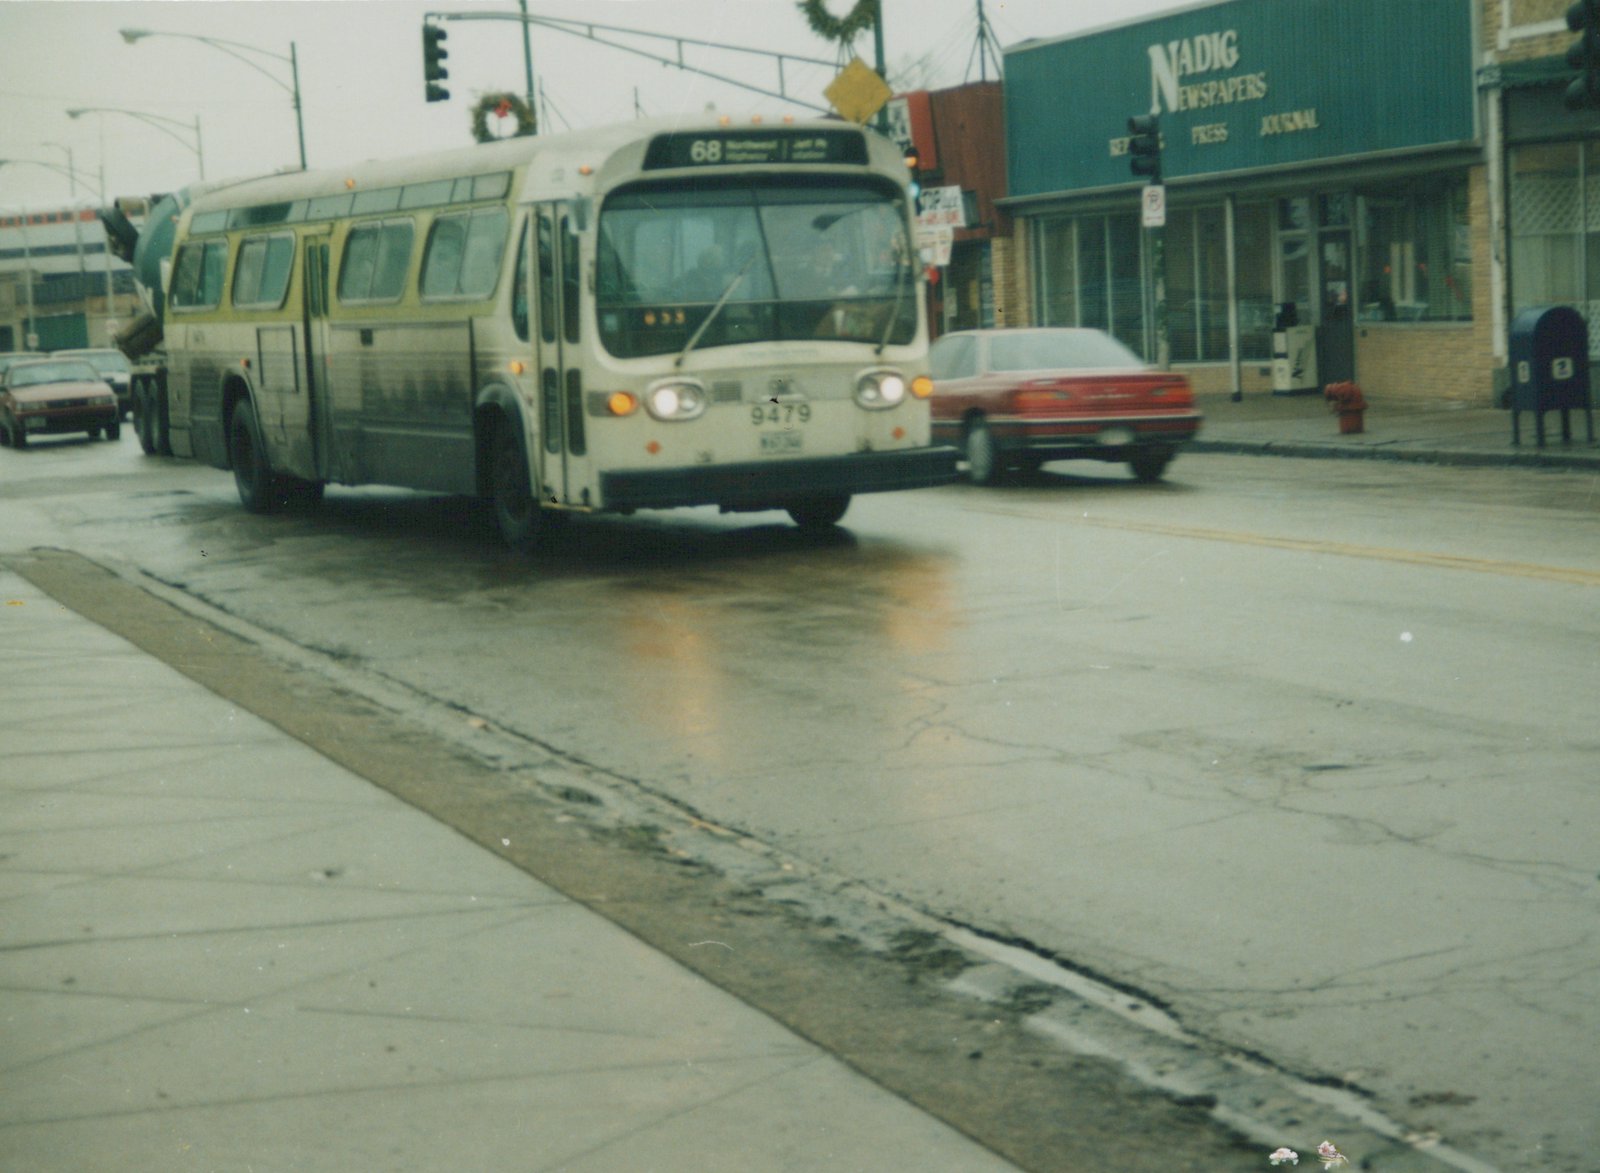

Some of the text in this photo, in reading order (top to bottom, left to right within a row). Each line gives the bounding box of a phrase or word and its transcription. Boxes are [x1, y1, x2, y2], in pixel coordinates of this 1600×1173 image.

[1148, 29, 1239, 115] NADIG
[1192, 122, 1228, 144] PRESS
[1260, 108, 1319, 136] JOURNAL
[690, 139, 721, 162] 68
[752, 404, 811, 425] 9479
